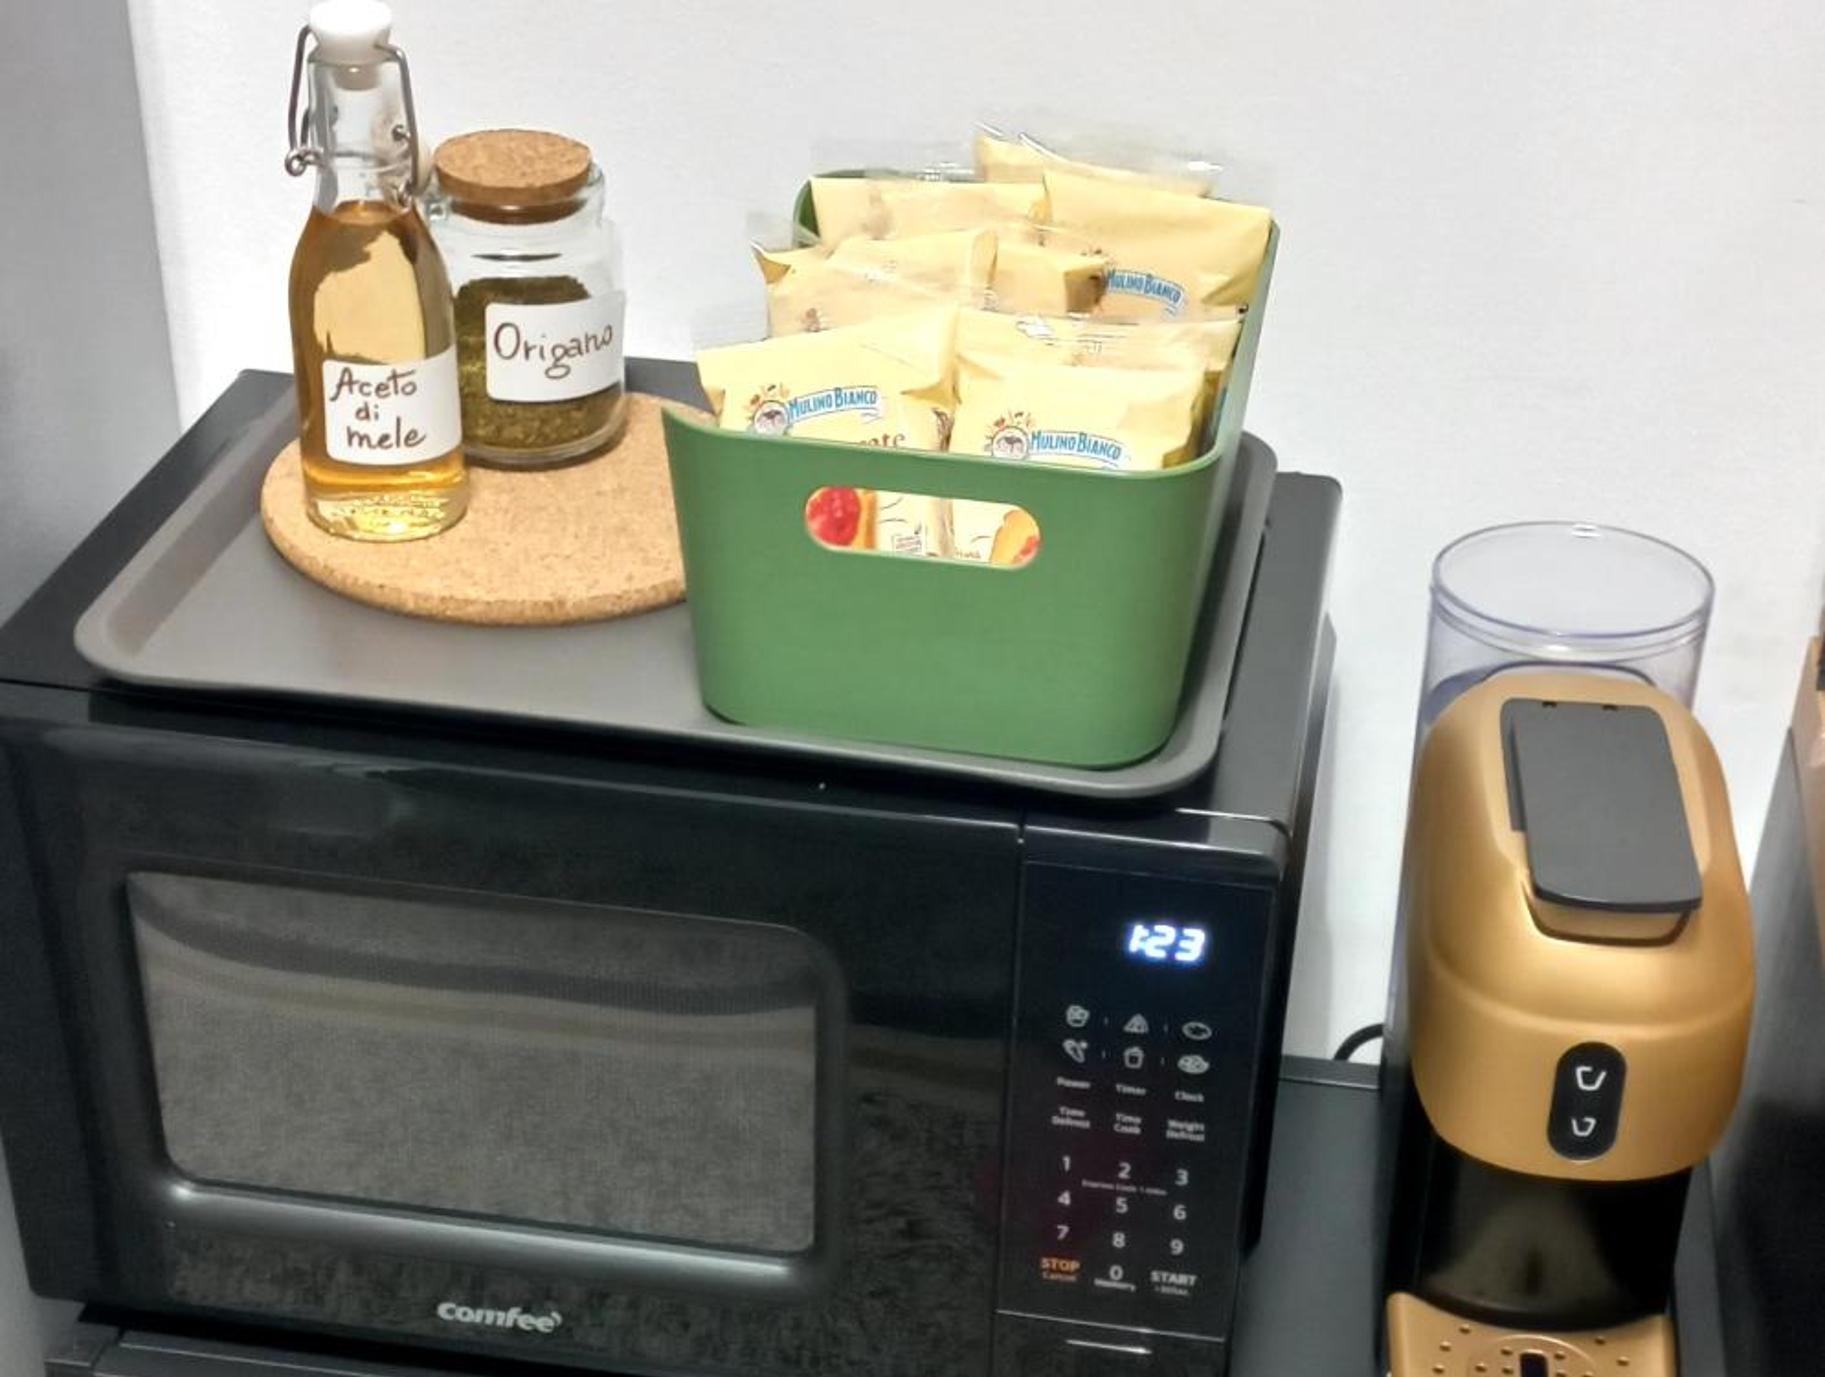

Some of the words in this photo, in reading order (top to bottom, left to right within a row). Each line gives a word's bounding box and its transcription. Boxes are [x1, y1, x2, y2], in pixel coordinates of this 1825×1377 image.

[494, 322, 613, 379] Origano
[329, 367, 417, 401] Aceto
[788, 393, 832, 418] MULINO
[834, 387, 878, 406] BIANCO
[355, 402, 379, 420] di
[347, 416, 427, 450] mele
[1031, 431, 1076, 450] MULINO
[1077, 432, 1122, 460] BIANCO
[1062, 1155, 1071, 1172] 1
[1118, 1162, 1131, 1179] 2
[1175, 1169, 1189, 1186] 3
[1057, 1190, 1071, 1206] 4
[1116, 1197, 1128, 1213] 5
[1173, 1204, 1187, 1220] 6
[1057, 1225, 1069, 1240] 7
[1112, 1232, 1125, 1248] 8
[1170, 1239, 1184, 1255] 9
[1041, 1257, 1080, 1272] STOP
[1109, 1265, 1123, 1281] 0
[1151, 1270, 1197, 1286] START
